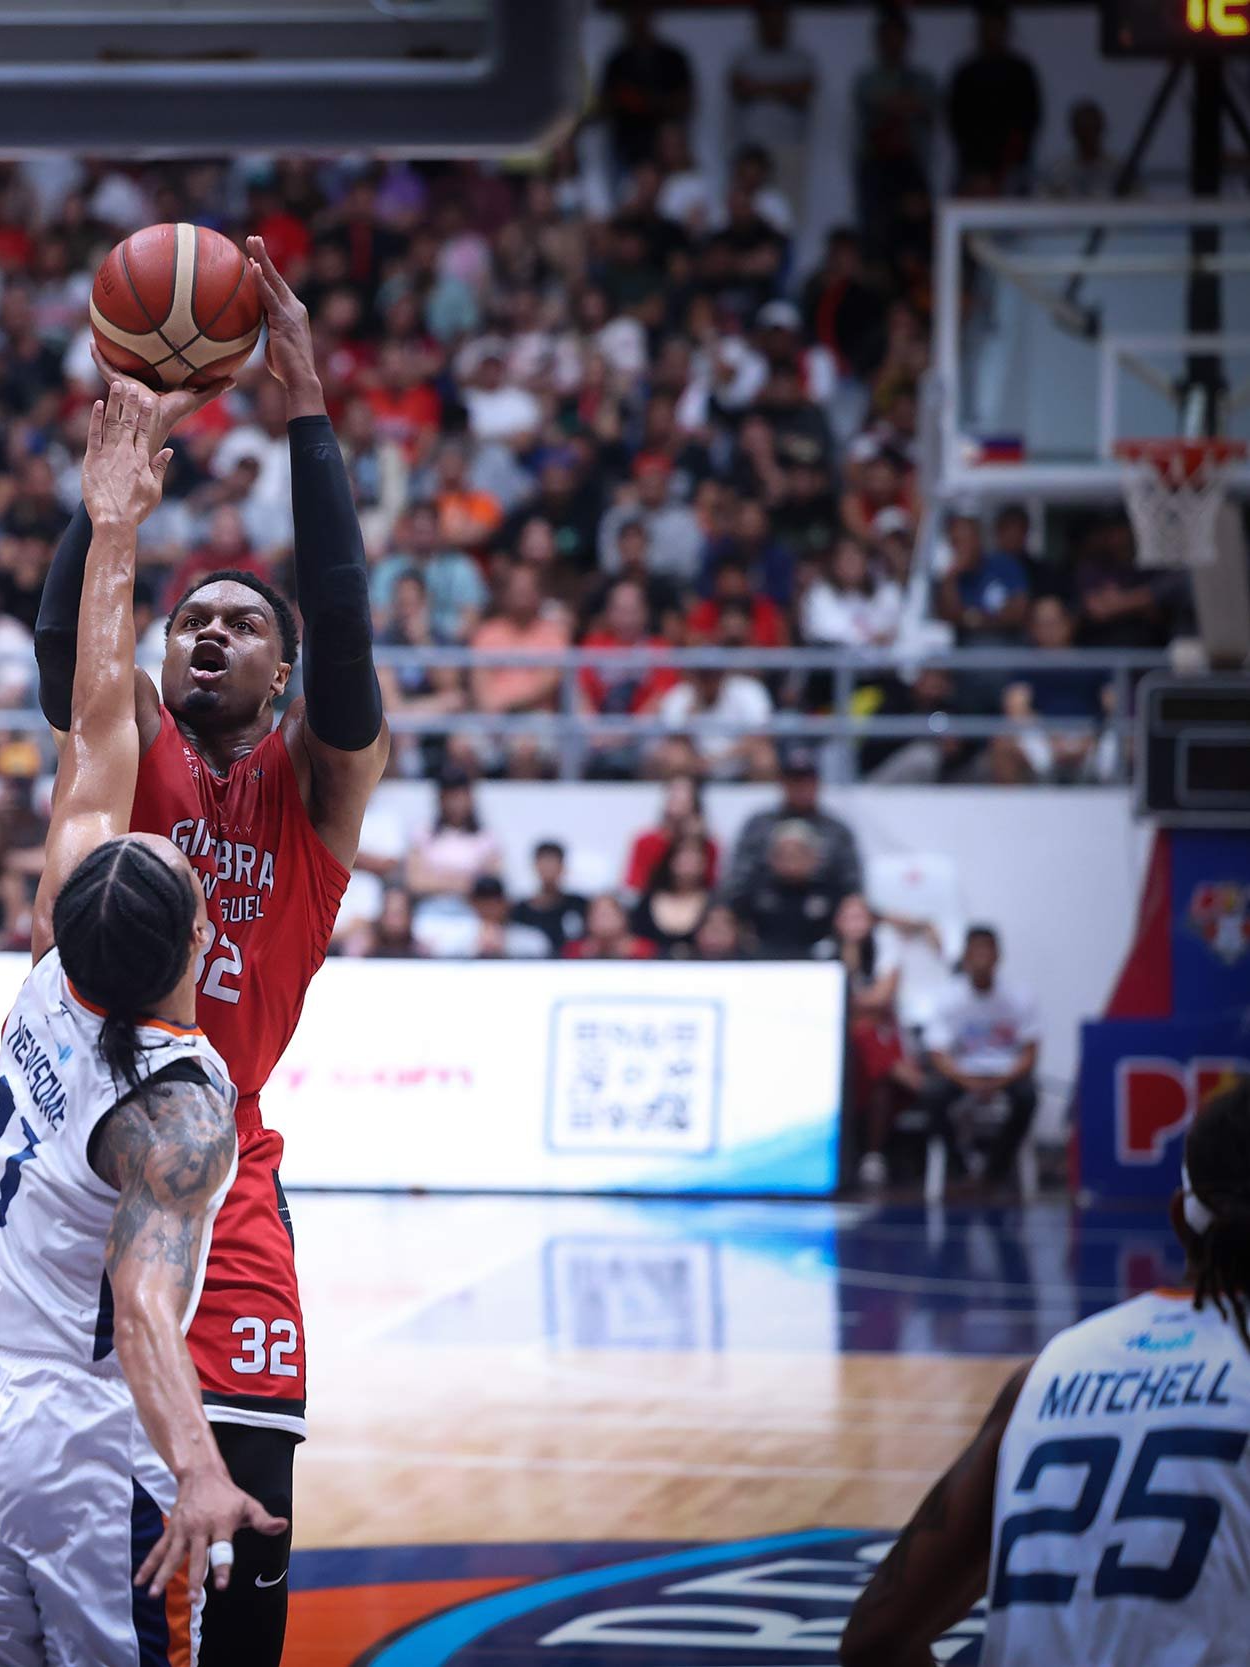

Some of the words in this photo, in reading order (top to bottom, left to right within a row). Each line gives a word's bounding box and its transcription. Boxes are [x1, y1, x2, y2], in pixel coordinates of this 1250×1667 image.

[6, 1015, 68, 1132] NEWSOME
[231, 1316, 298, 1378] 32
[1038, 1361, 1232, 1422] MITCHELL
[991, 1427, 1249, 1612] 25
